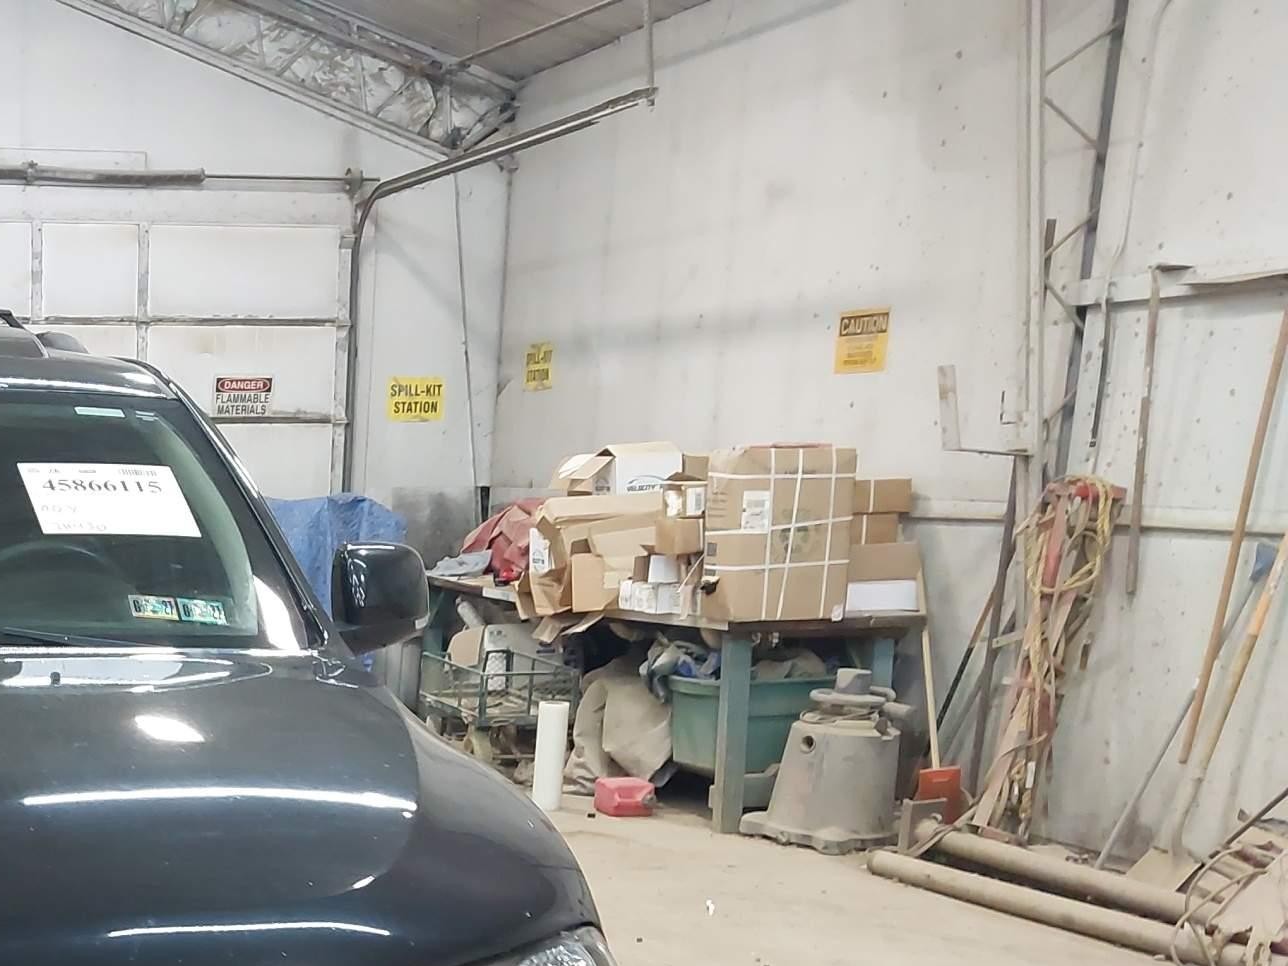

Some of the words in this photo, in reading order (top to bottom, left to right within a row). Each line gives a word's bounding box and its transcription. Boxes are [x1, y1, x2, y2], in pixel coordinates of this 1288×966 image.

[841, 315, 888, 335] CAUTION
[224, 380, 265, 391] DANGER
[390, 383, 443, 398] SPILL-KIT
[215, 393, 270, 404] FLAMMABLE
[216, 404, 267, 416] MATERIALS
[393, 401, 438, 414] STATION
[42, 479, 163, 494] 45866115
